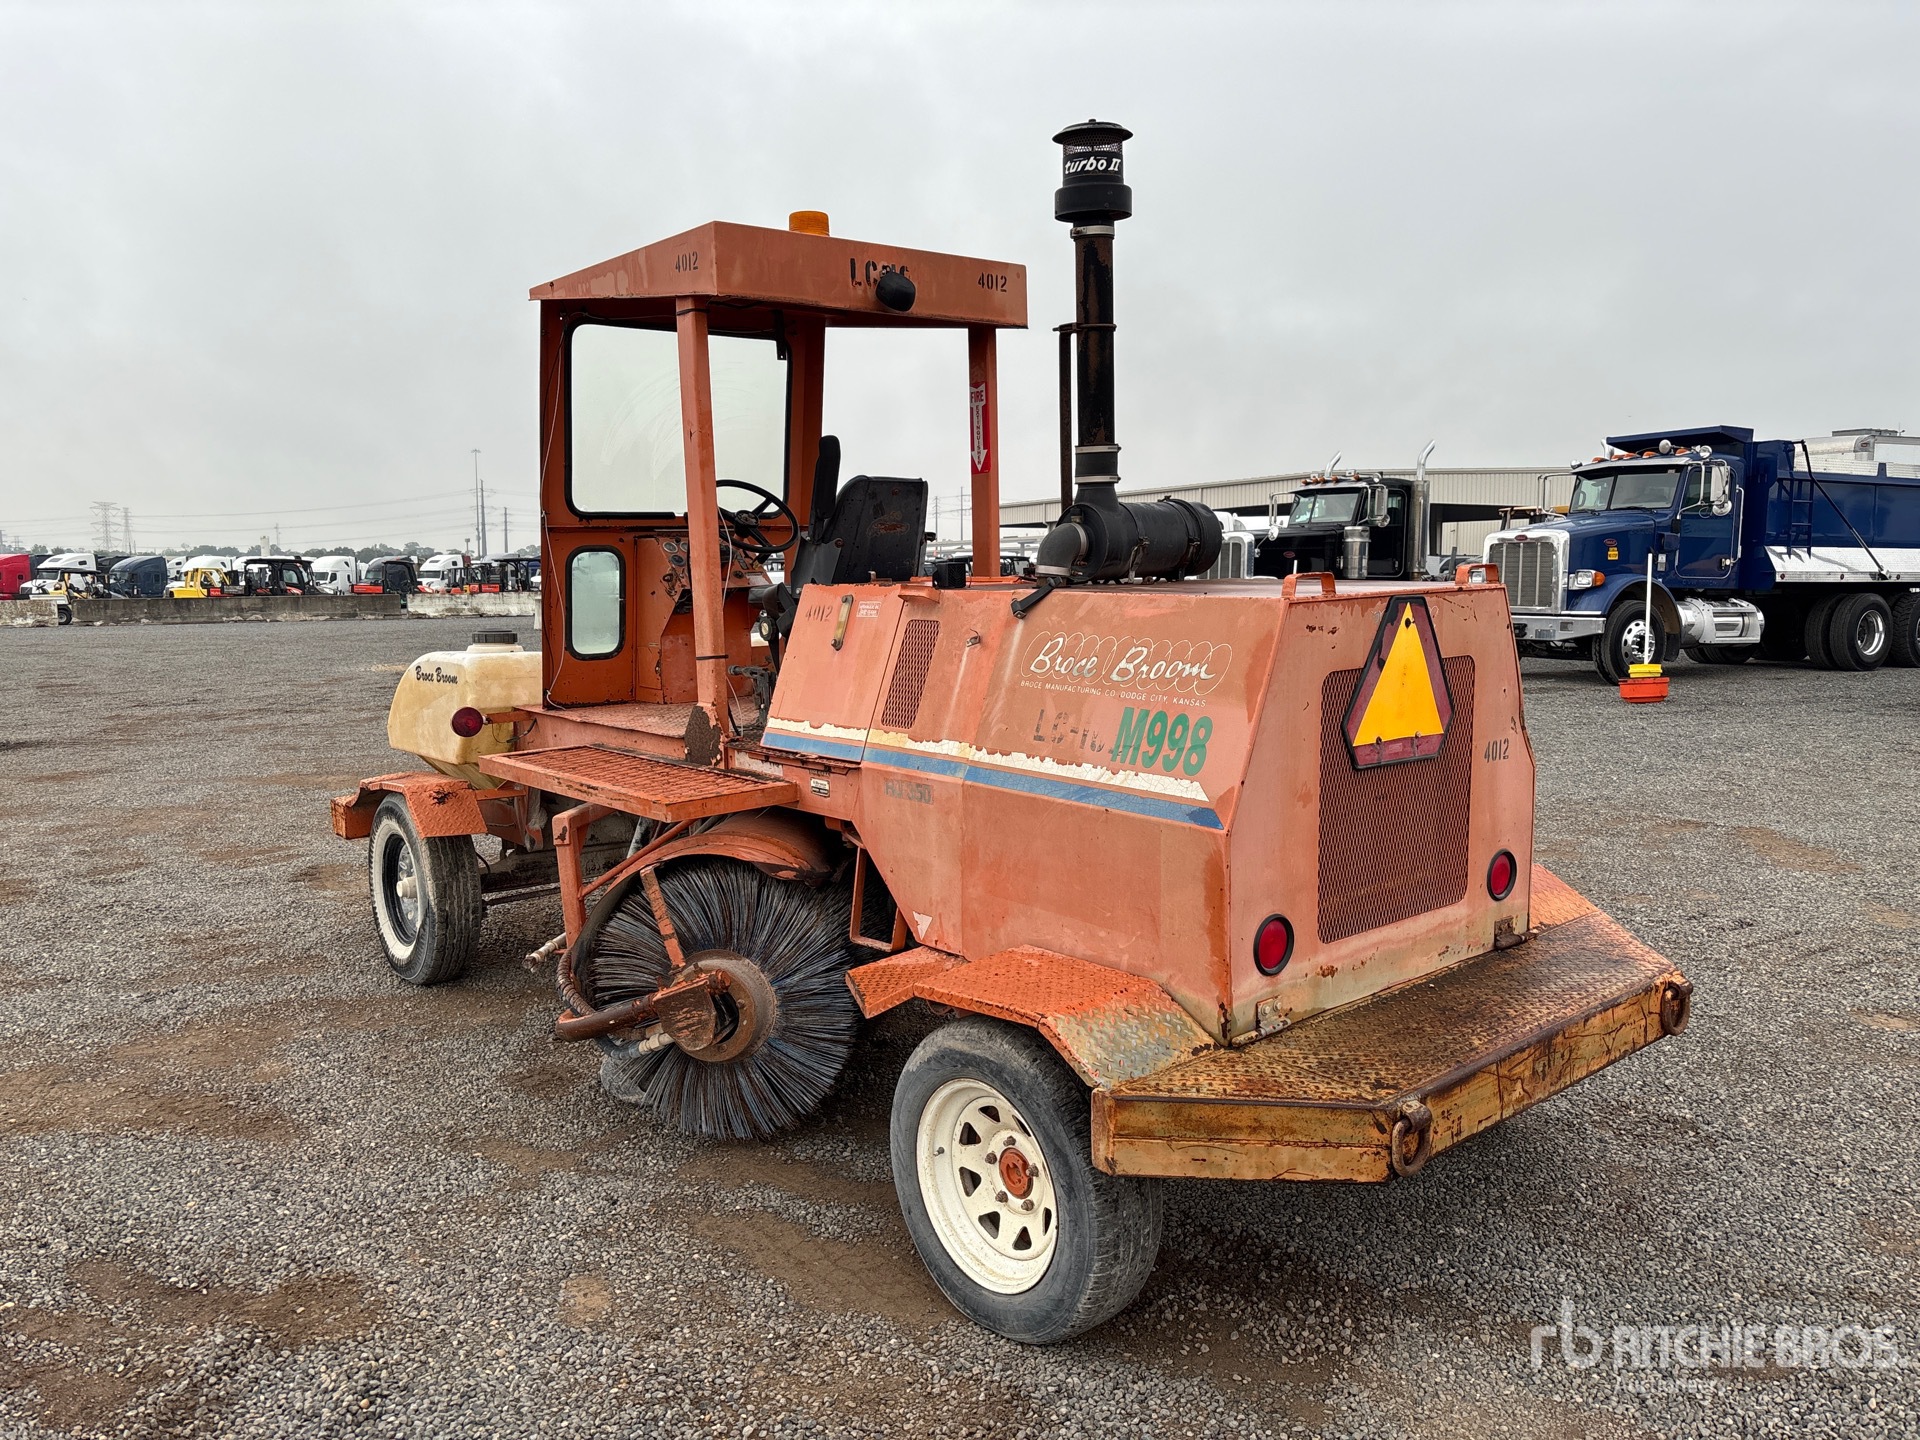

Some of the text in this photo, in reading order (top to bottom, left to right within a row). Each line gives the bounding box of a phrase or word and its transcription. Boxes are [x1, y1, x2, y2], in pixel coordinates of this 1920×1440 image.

[1064, 156, 1107, 175] turbo
[675, 251, 699, 273] 4012
[977, 272, 1008, 293] 4012
[970, 390, 984, 403] FIRE
[1030, 637, 1216, 682] Broce Broom
[415, 665, 458, 684] Broce Broom
[1020, 680, 1043, 689] BROCE
[1045, 683, 1101, 696] MANUFACTURING
[1120, 691, 1147, 701] DODGE
[1172, 696, 1207, 708] KANSAS
[1110, 706, 1214, 776] M998
[1484, 737, 1510, 764] 4012
